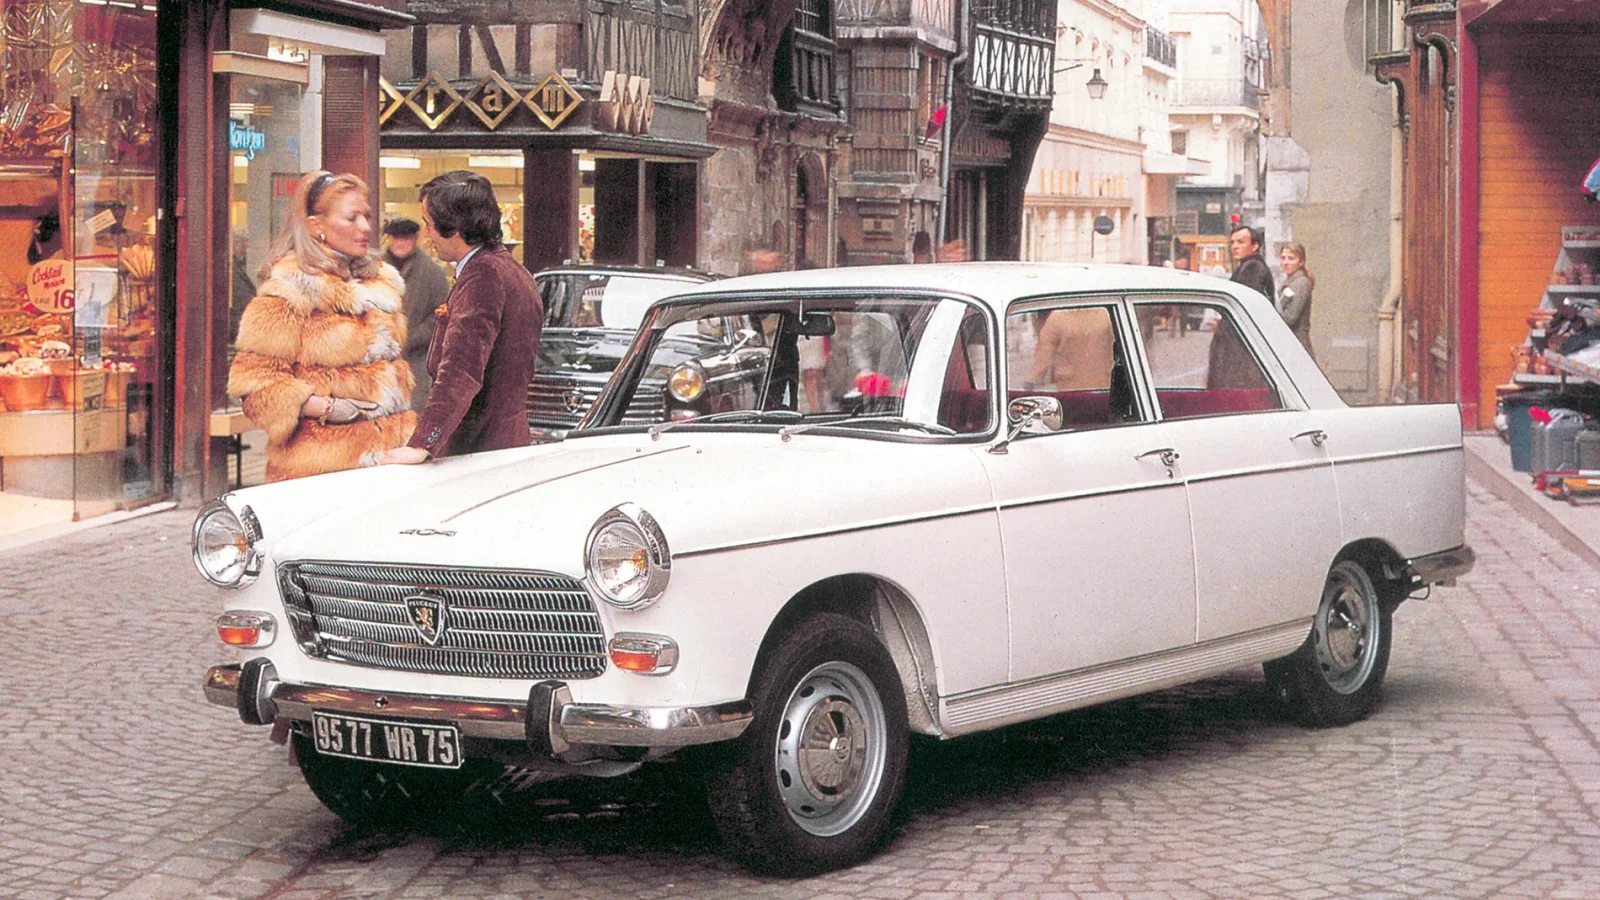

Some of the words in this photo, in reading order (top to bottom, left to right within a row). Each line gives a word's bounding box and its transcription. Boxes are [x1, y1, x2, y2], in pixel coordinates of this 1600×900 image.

[54, 289, 75, 310] 16
[384, 726, 417, 761] WR
[422, 729, 454, 764] 75
